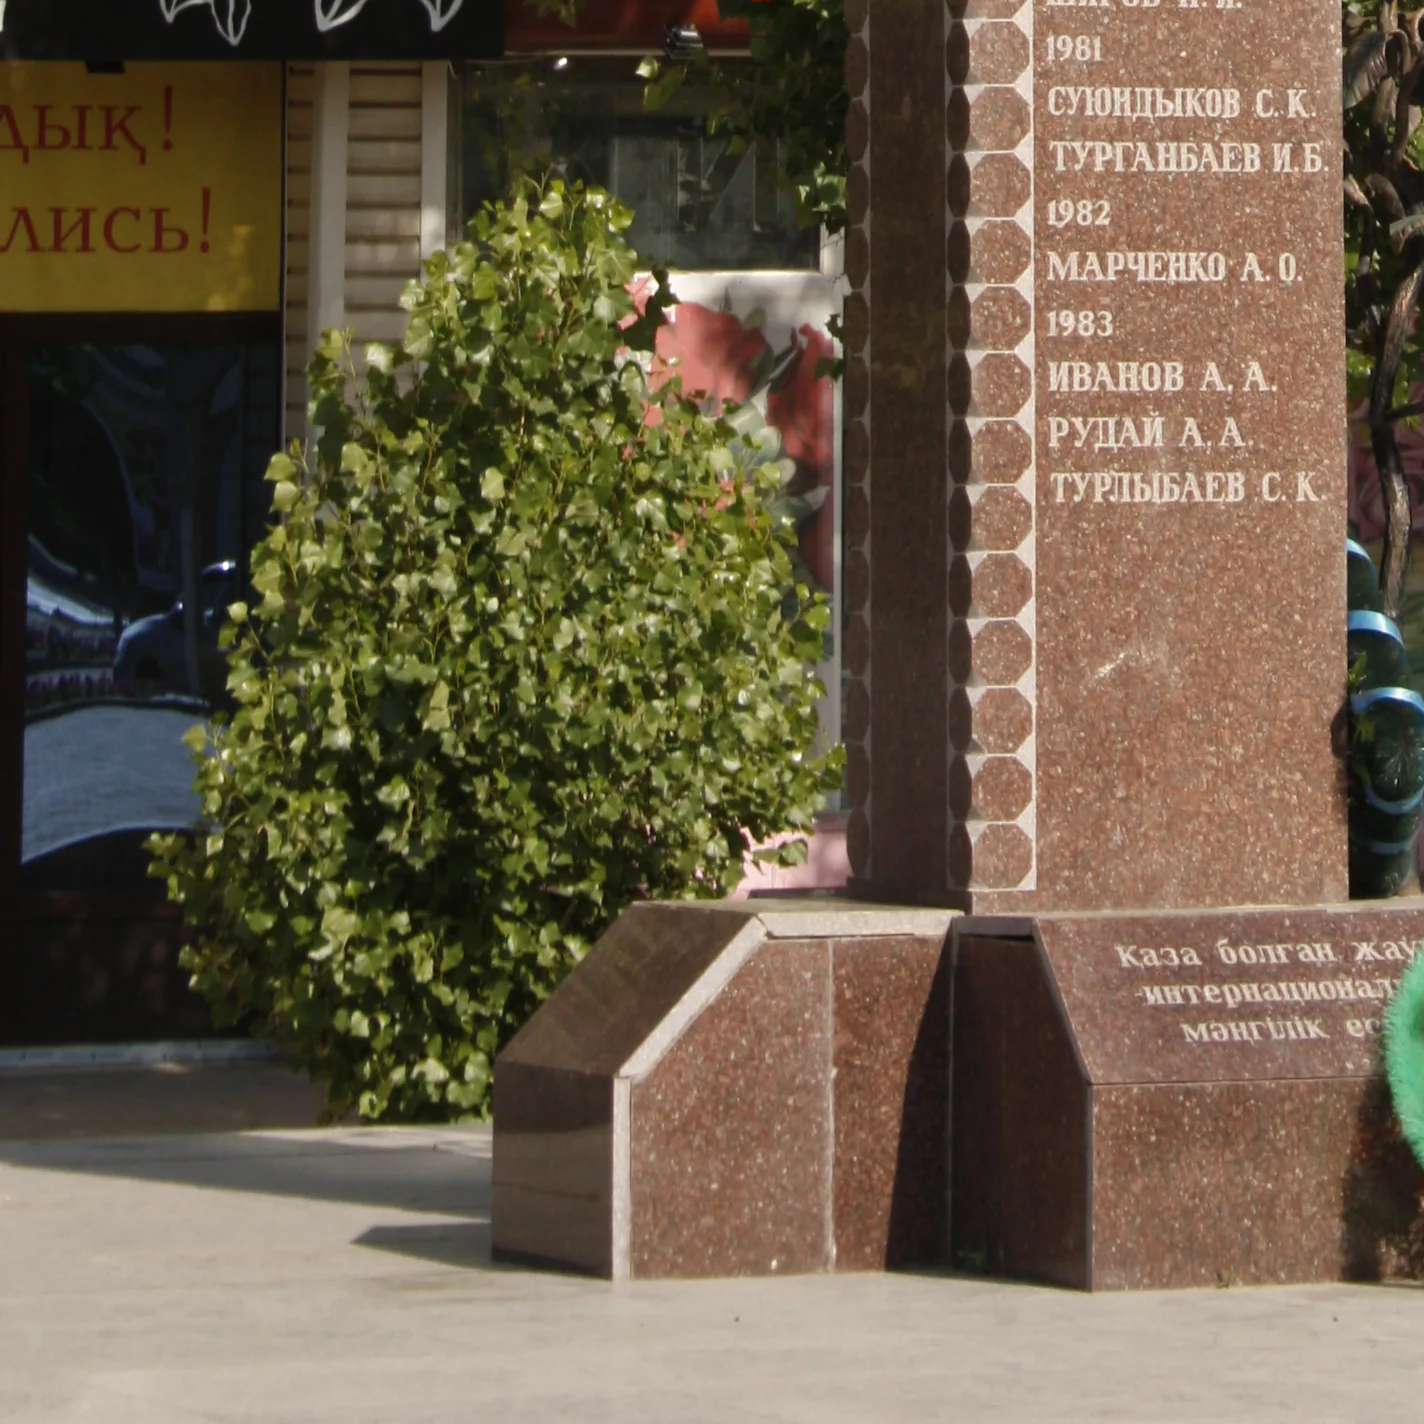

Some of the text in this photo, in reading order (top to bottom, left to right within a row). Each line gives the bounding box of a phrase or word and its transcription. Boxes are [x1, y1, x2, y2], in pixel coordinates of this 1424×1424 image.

[1046, 35, 1101, 61] 1981
[1049, 86, 1241, 122] СУЮНДЫКОВ
[1050, 140, 1261, 173] ТУРГАНБАЕВ
[1046, 199, 1111, 227] 1982
[1046, 251, 1303, 283] МАРЧЕНКО А. О.
[1047, 310, 1114, 336] 1983
[1048, 361, 1278, 393] ИВАНОВ А. А.
[1048, 412, 1165, 452] РУДАЙ
[1050, 471, 1246, 503] ТУРЛЫБАЕВ
